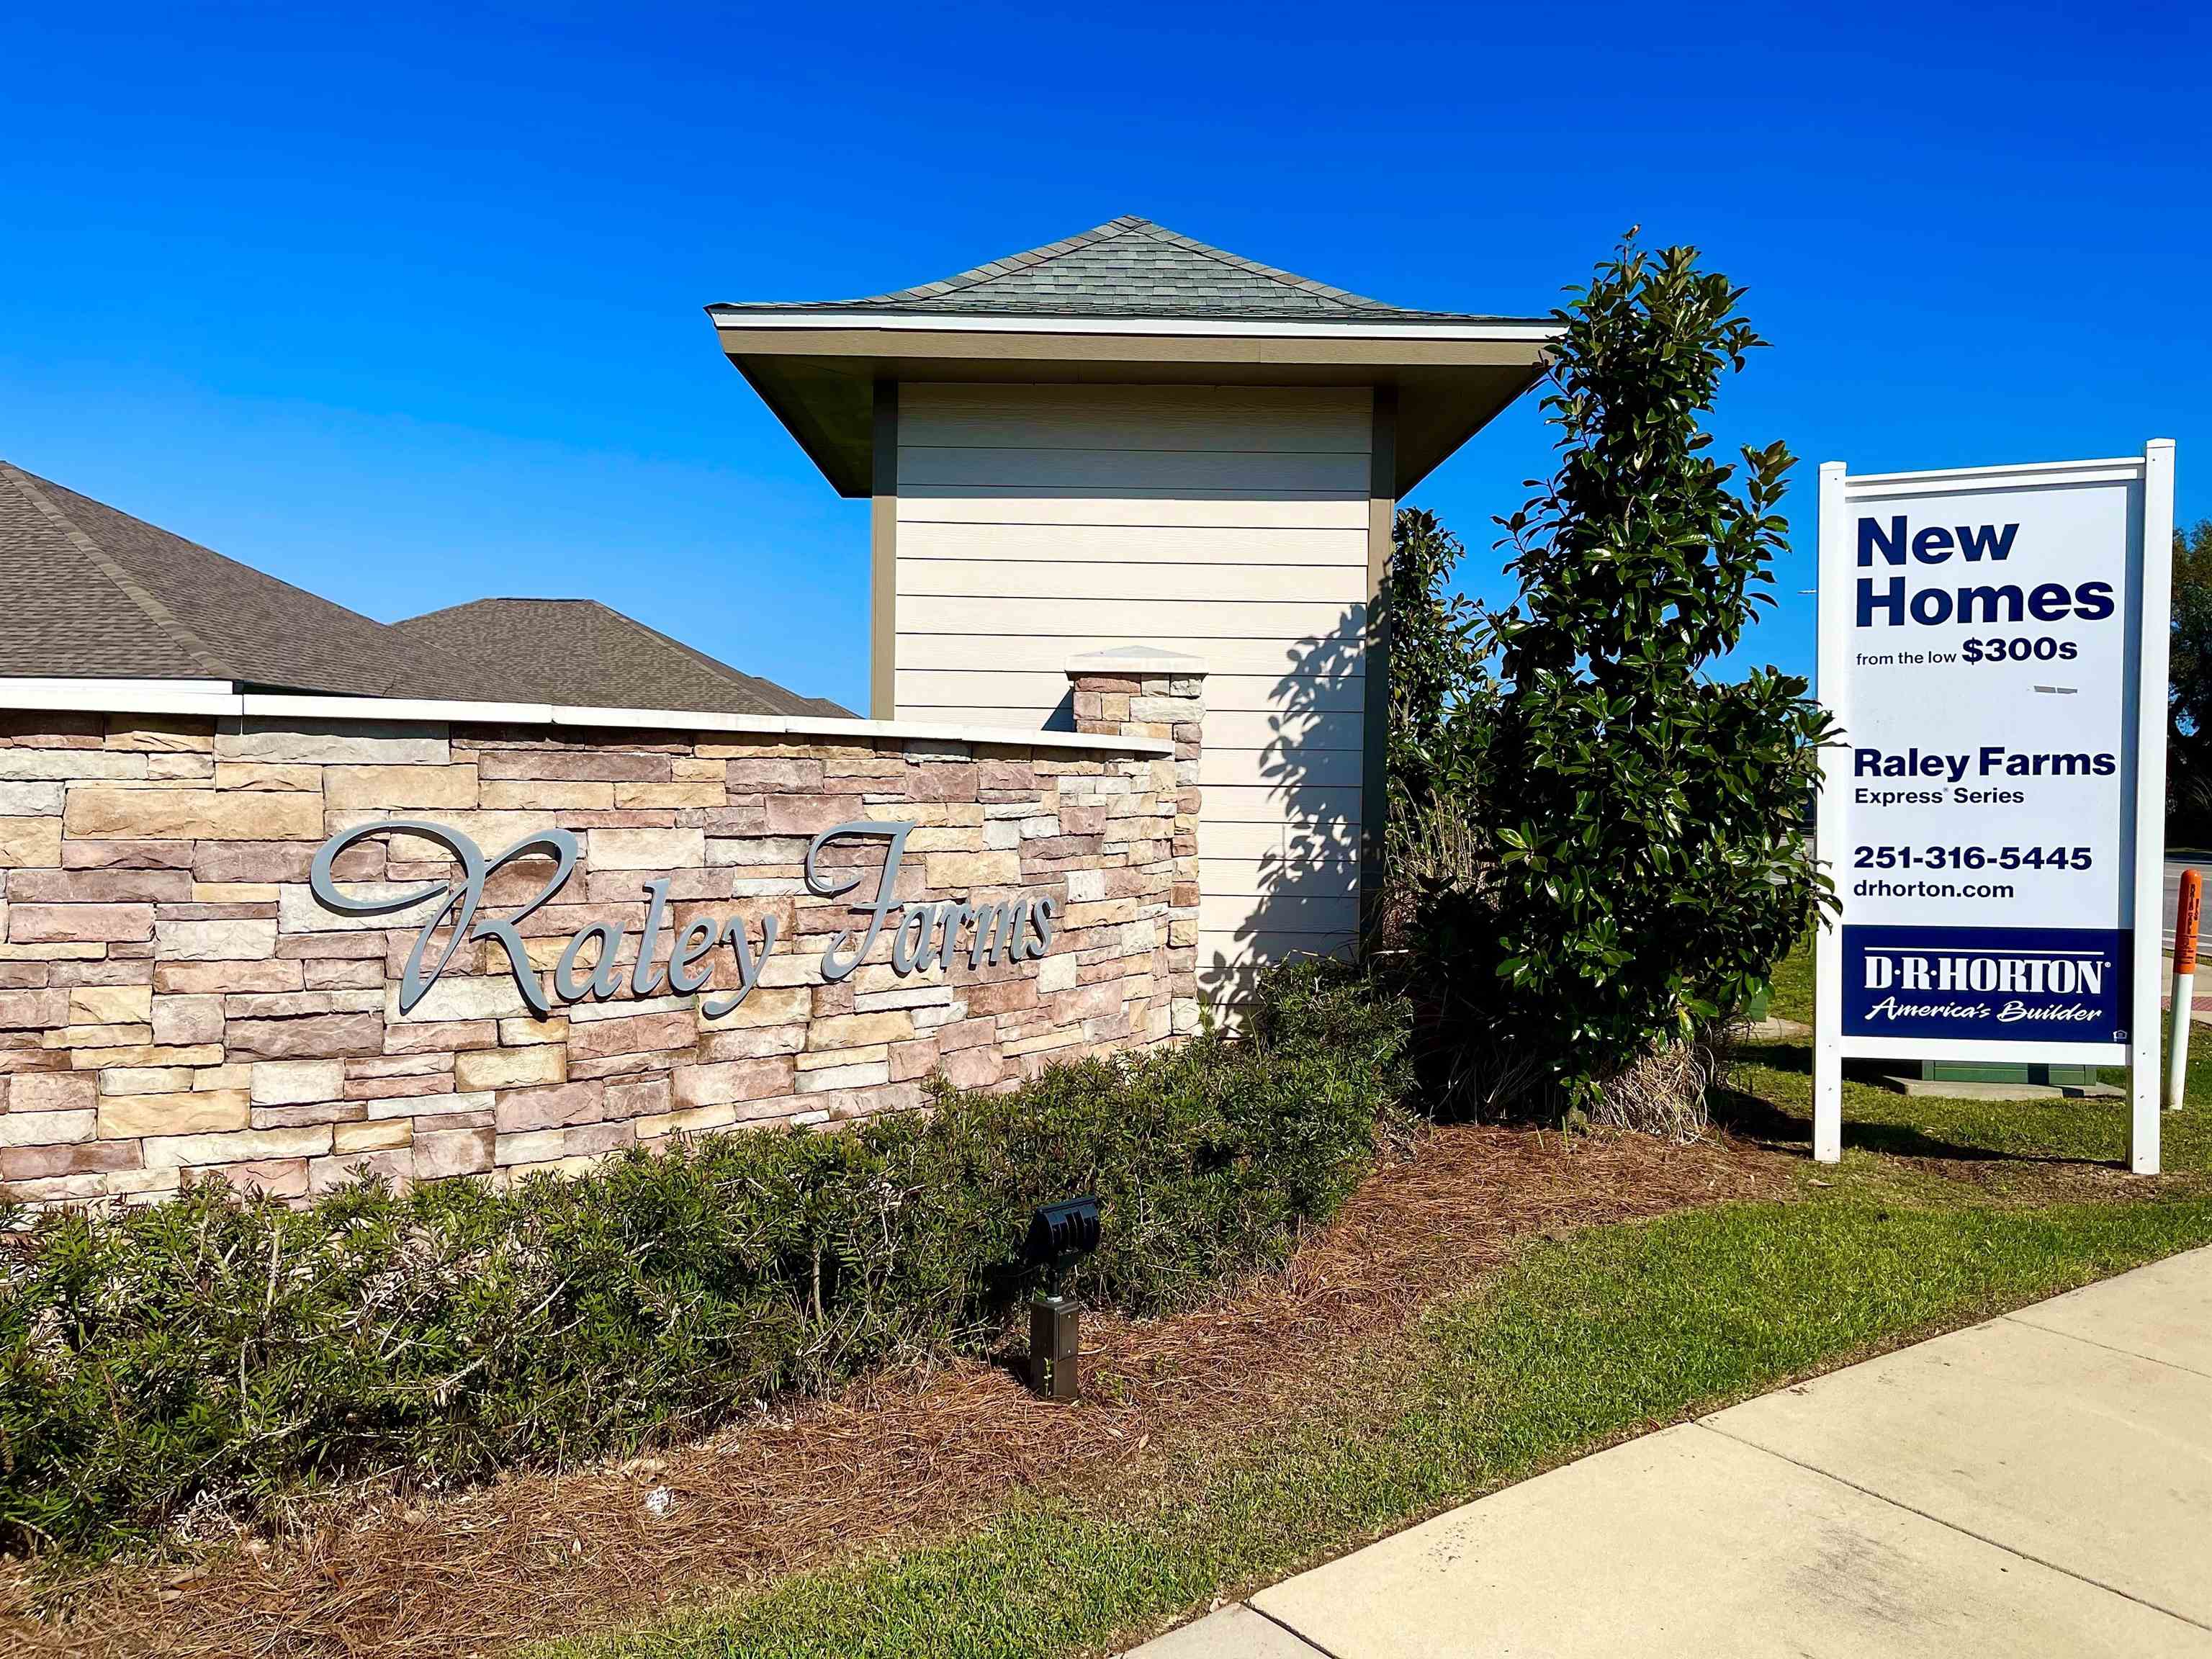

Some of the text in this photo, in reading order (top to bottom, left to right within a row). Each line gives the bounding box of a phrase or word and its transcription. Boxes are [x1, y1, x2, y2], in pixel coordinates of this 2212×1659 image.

[1857, 516, 2020, 567] New
[1856, 577, 2115, 627] Homes
[1856, 637, 2078, 665] from the low $300s
[1854, 747, 2116, 783] Raley Farms
[1954, 787, 2025, 804] Series
[1853, 846, 2092, 871] 251-316-5445
[1853, 879, 2014, 898] drhorton.com
[310, 820, 1056, 1016] Raley Farms
[1864, 996, 2103, 1022] America's Builder
